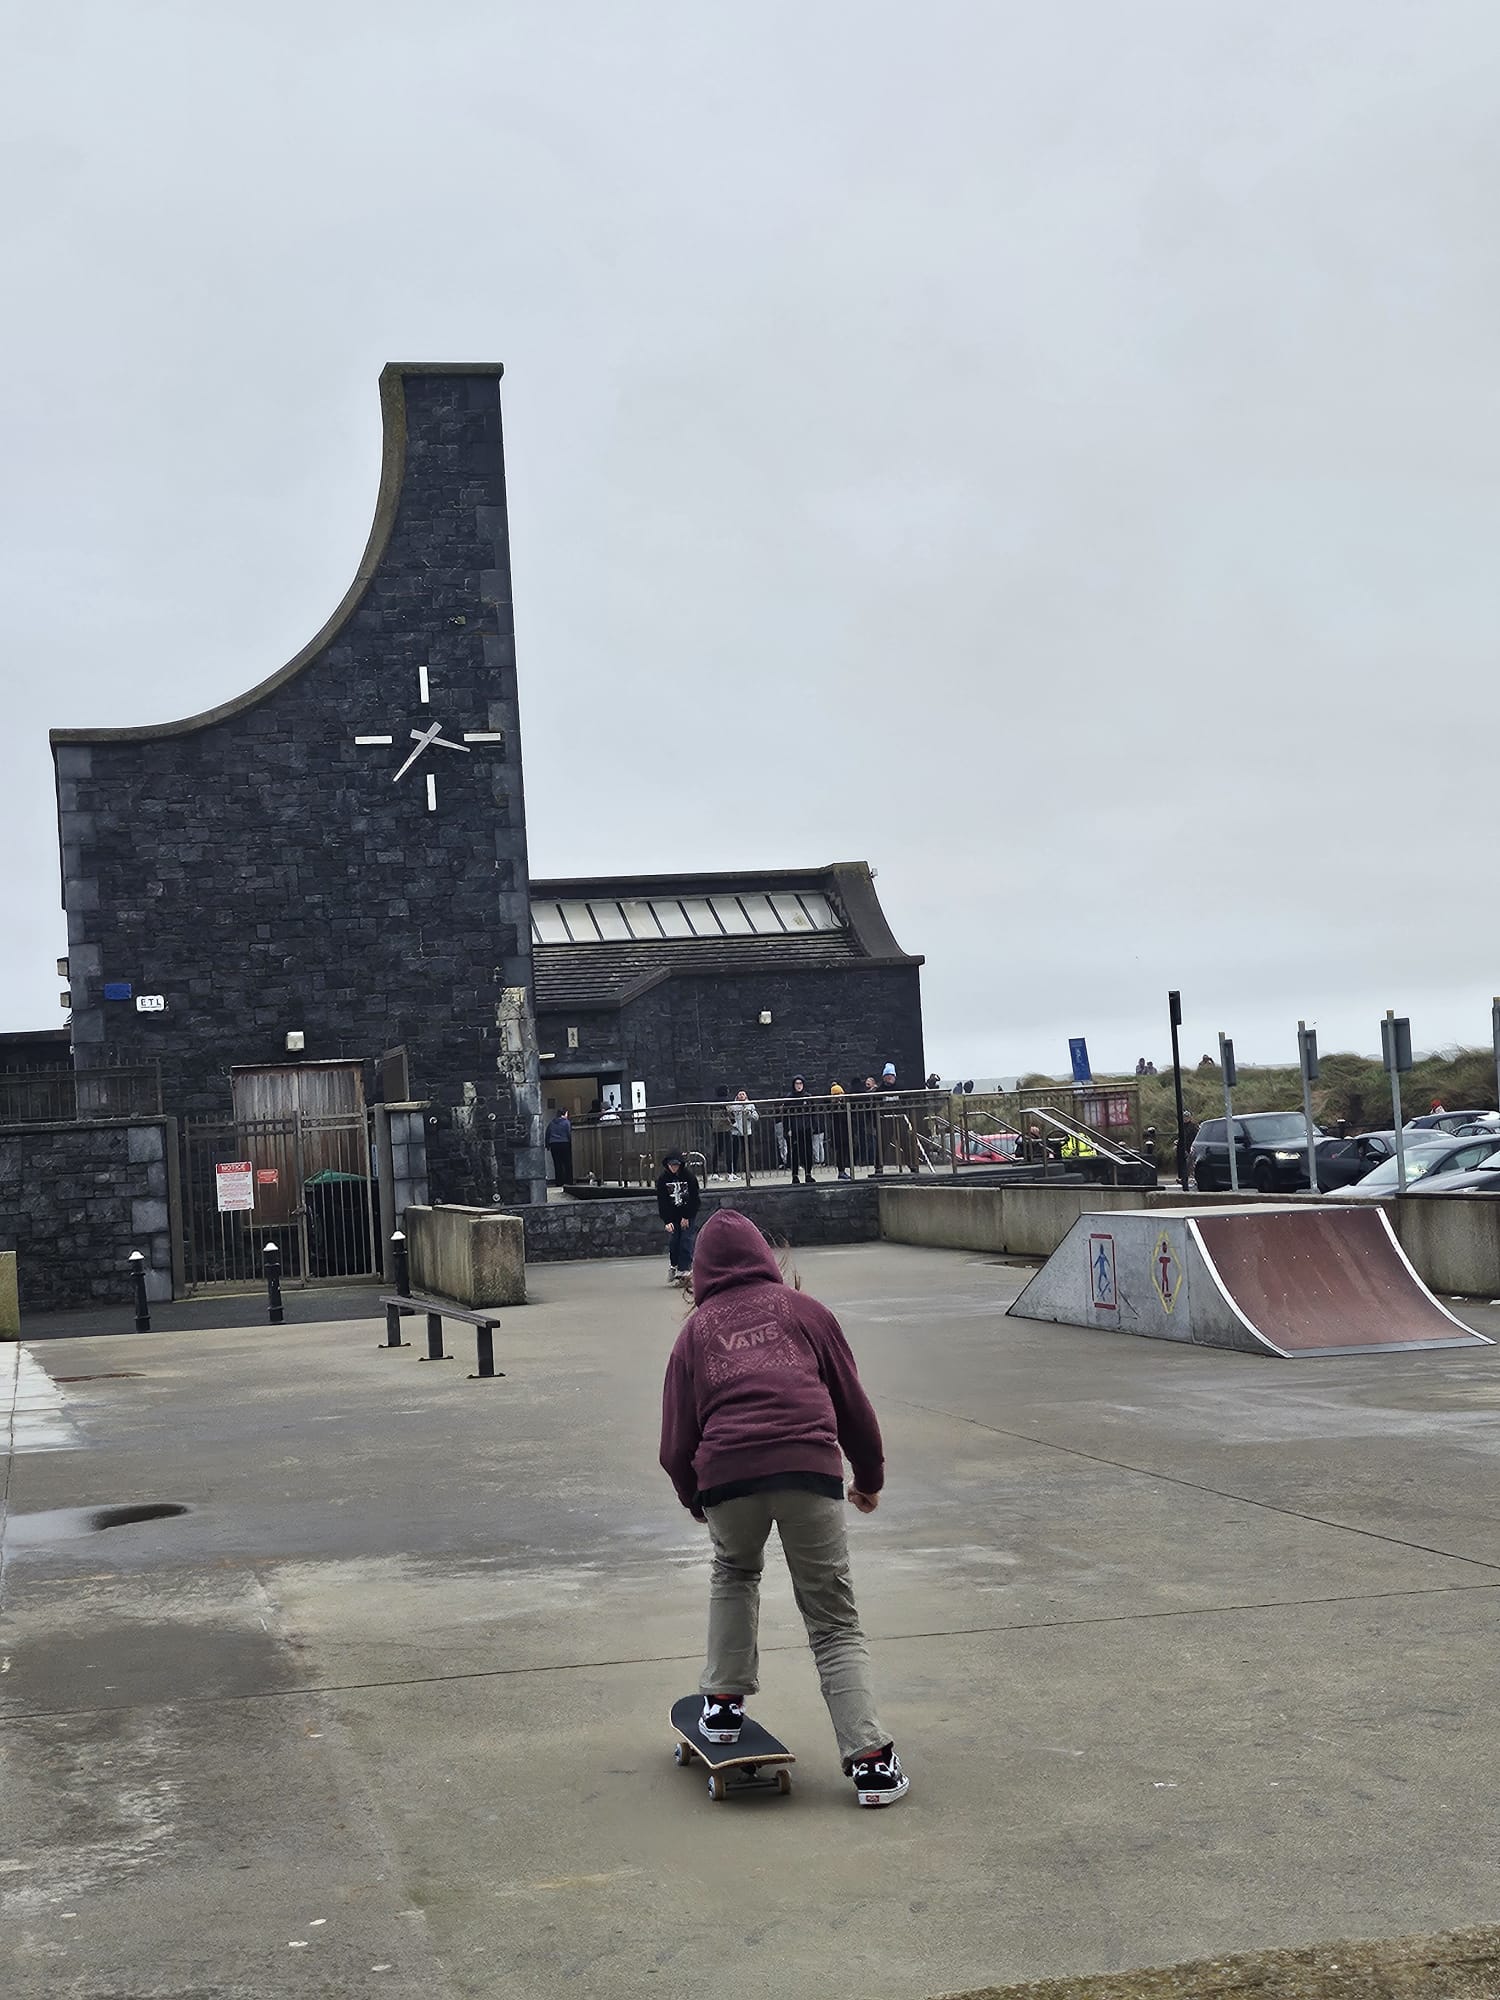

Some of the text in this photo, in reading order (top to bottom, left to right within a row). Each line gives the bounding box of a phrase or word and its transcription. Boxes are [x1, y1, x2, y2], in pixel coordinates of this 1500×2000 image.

[140, 998, 162, 1007] ETL
[221, 1164, 246, 1173] NOTICE
[716, 1321, 779, 1351] VANS
